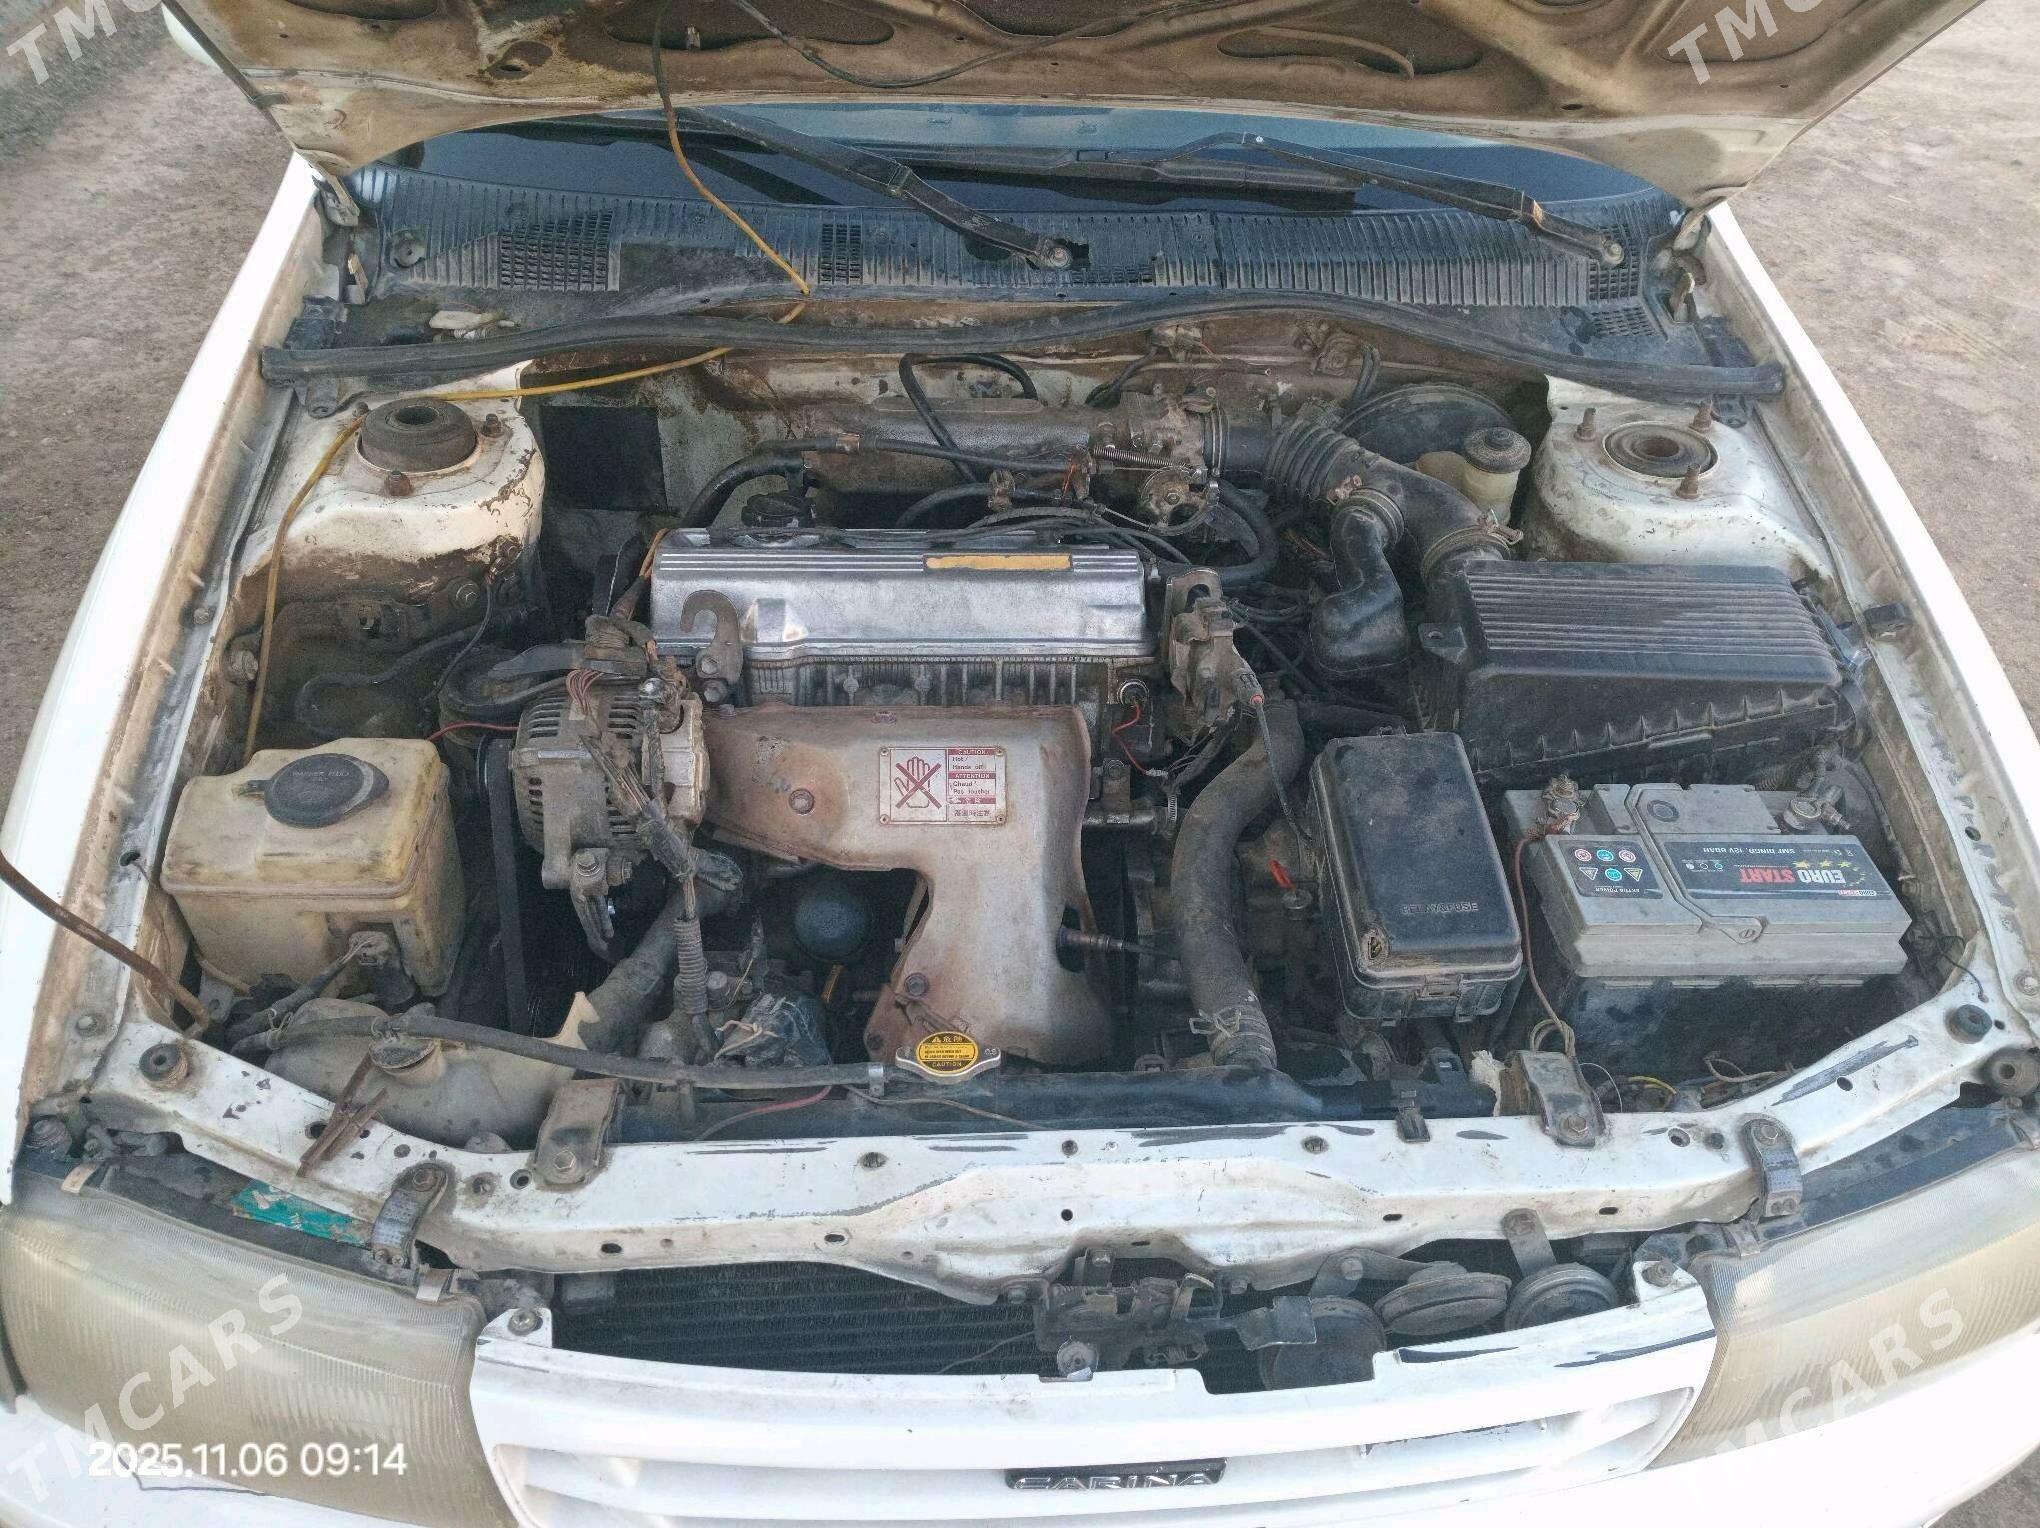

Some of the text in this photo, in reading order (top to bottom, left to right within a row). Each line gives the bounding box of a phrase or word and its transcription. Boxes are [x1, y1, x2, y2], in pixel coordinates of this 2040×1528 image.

[1739, 868, 1847, 885] EURO START
[1013, 1473, 1215, 1489] CARINA
